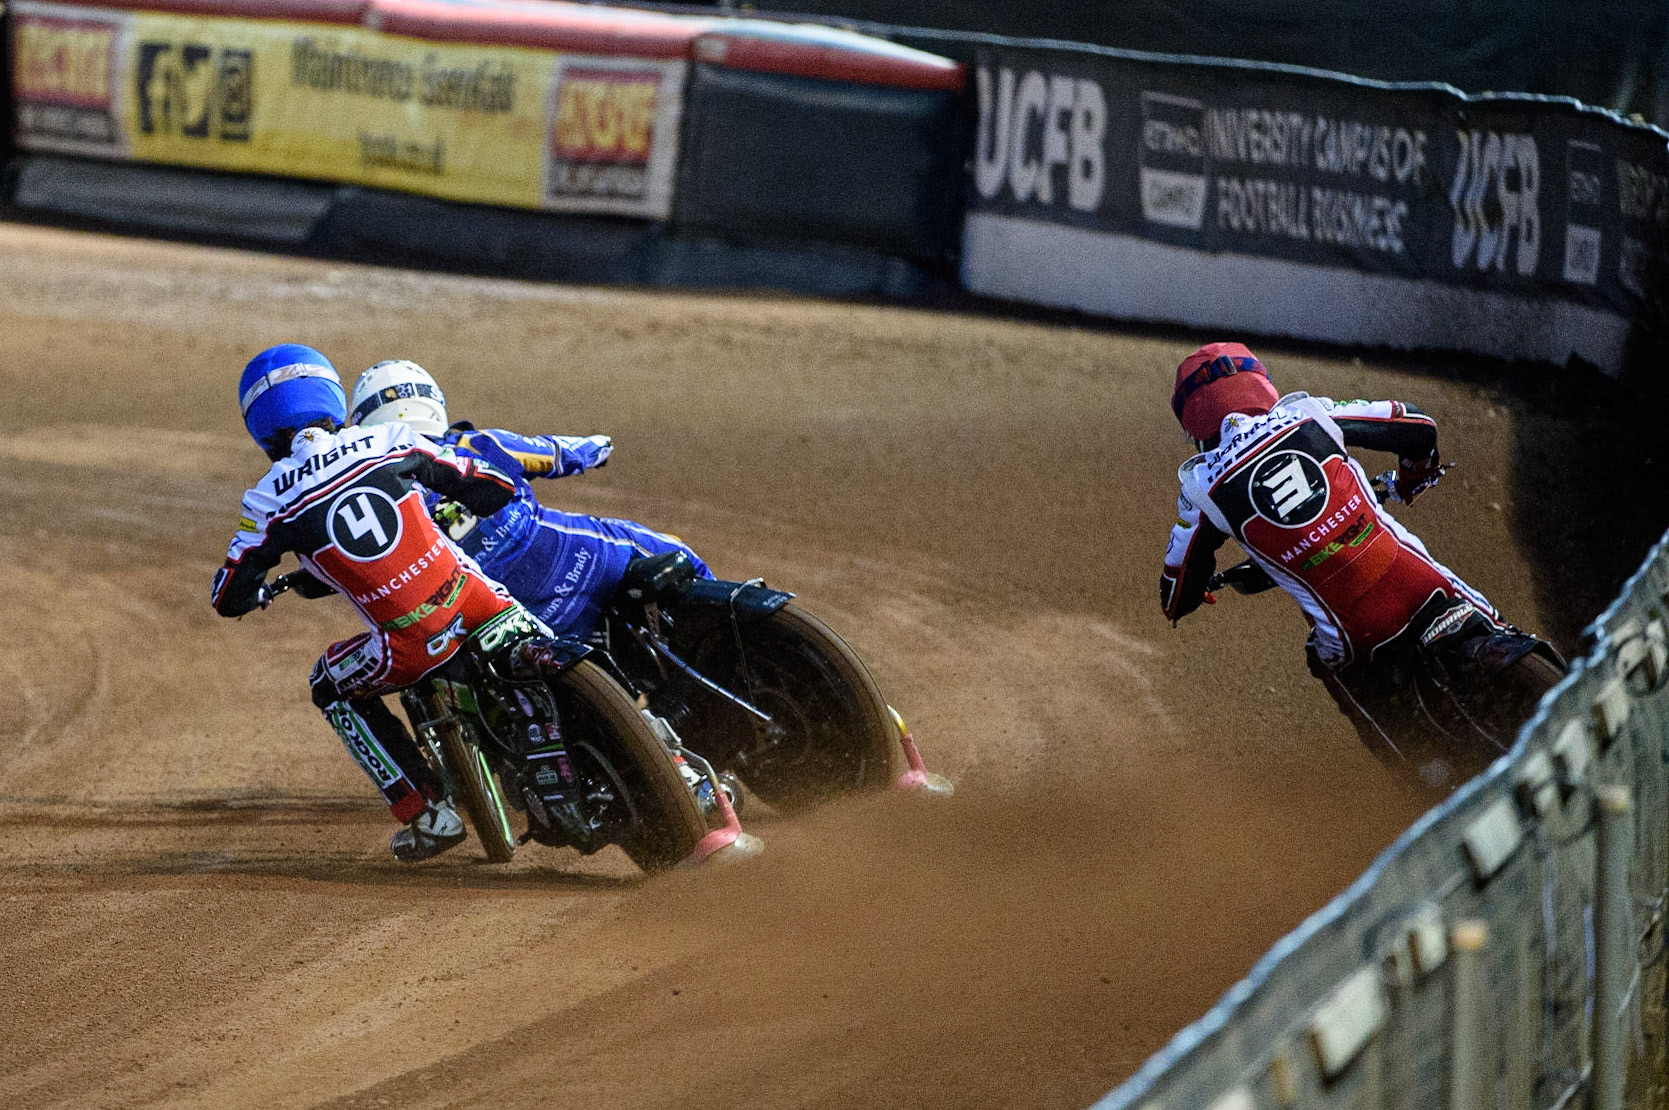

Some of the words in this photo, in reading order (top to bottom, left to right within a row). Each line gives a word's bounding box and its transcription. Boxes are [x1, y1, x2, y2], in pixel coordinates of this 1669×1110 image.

[974, 67, 1106, 212] UCFB
[1313, 115, 1391, 180] CAMPUS
[1392, 127, 1427, 185] OF
[1216, 175, 1309, 240] FOOTBALL
[1311, 186, 1408, 254] BUSINESS
[1450, 129, 1540, 276] UCFB
[273, 436, 374, 496] WRIGHT
[1262, 459, 1314, 519] 3
[337, 493, 389, 547] 4
[495, 508, 523, 538] Brady
[1281, 494, 1361, 563] MANCHESTER
[355, 537, 446, 604] MANCHESTER
[554, 585, 573, 598] &
[565, 547, 592, 585] Brady
[350, 733, 392, 782] ROCK
